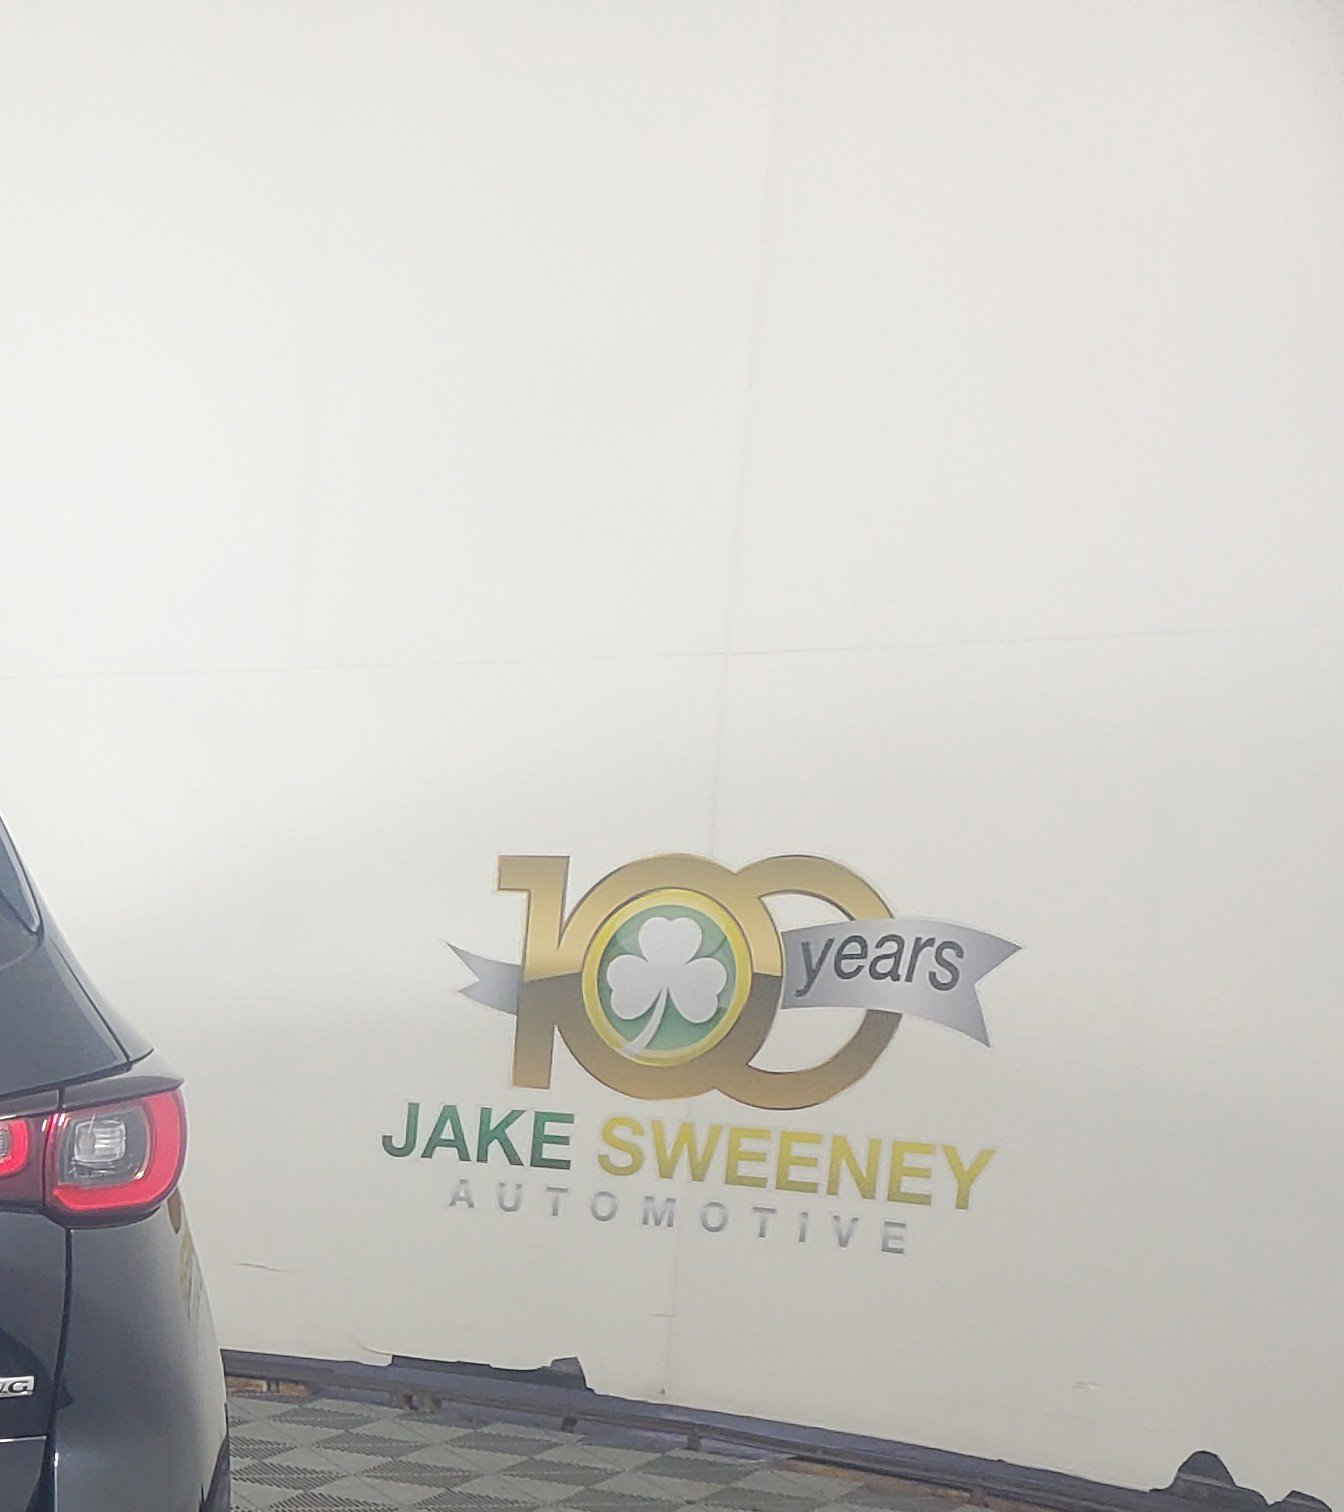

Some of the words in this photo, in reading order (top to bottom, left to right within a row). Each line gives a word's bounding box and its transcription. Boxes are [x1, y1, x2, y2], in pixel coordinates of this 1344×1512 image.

[497, 853, 904, 1111] 100
[794, 932, 966, 998] years
[381, 1101, 576, 1171] JAKE
[597, 1115, 997, 1211] SWEENEY
[449, 1178, 909, 1255] AUTOMOTIVE
